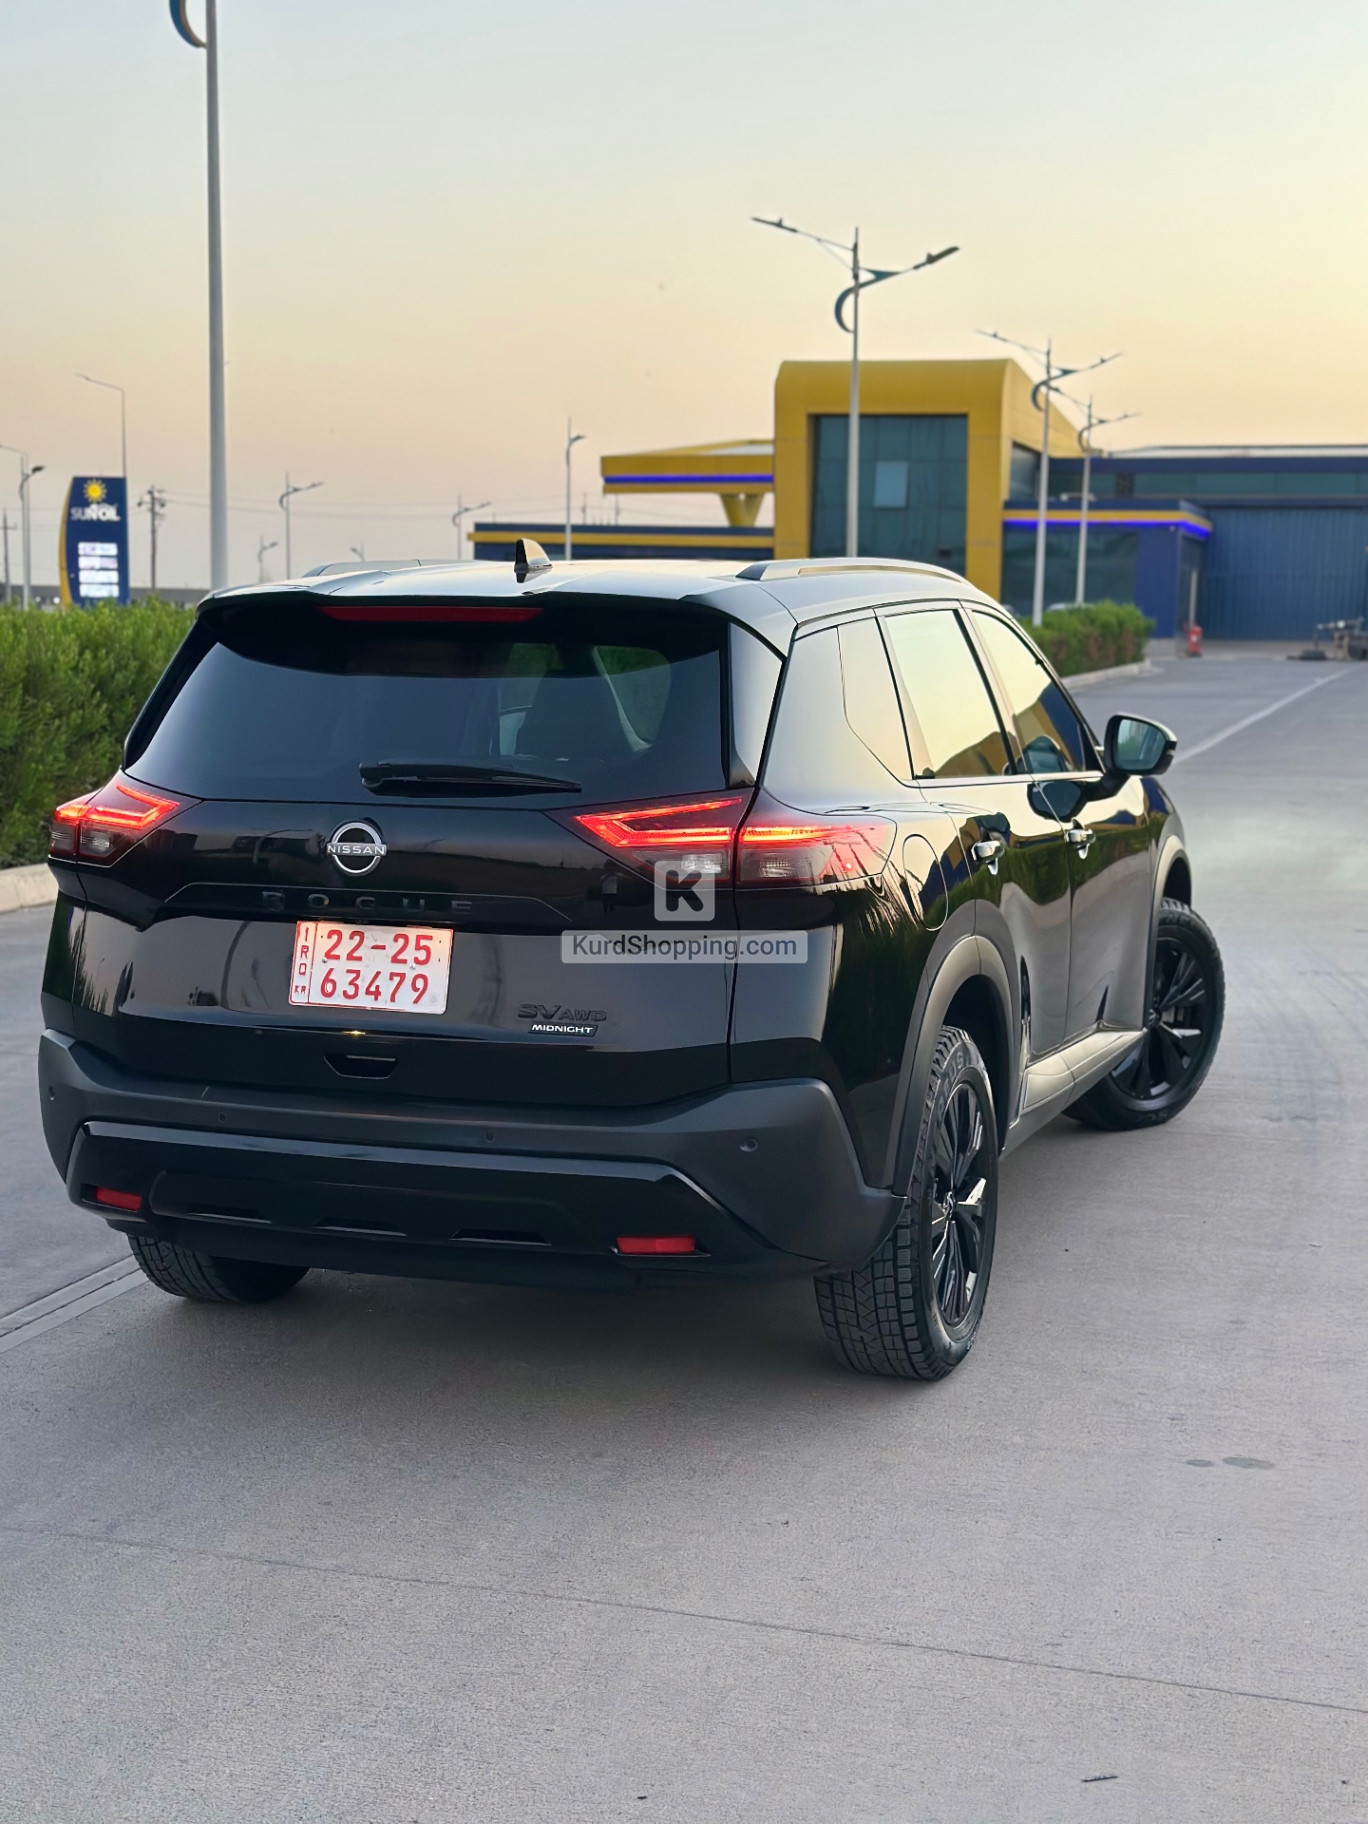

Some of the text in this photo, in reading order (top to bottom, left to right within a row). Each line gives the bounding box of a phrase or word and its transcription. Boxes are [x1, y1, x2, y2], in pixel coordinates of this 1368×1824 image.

[327, 843, 386, 856] NISSAN
[262, 891, 472, 915] ROGUE
[324, 929, 434, 966] 22-25
[294, 984, 307, 994] KR
[320, 967, 430, 1005] 63479
[518, 1003, 607, 1021] SV AWD
[531, 1024, 594, 1034] MIDNIGHT
